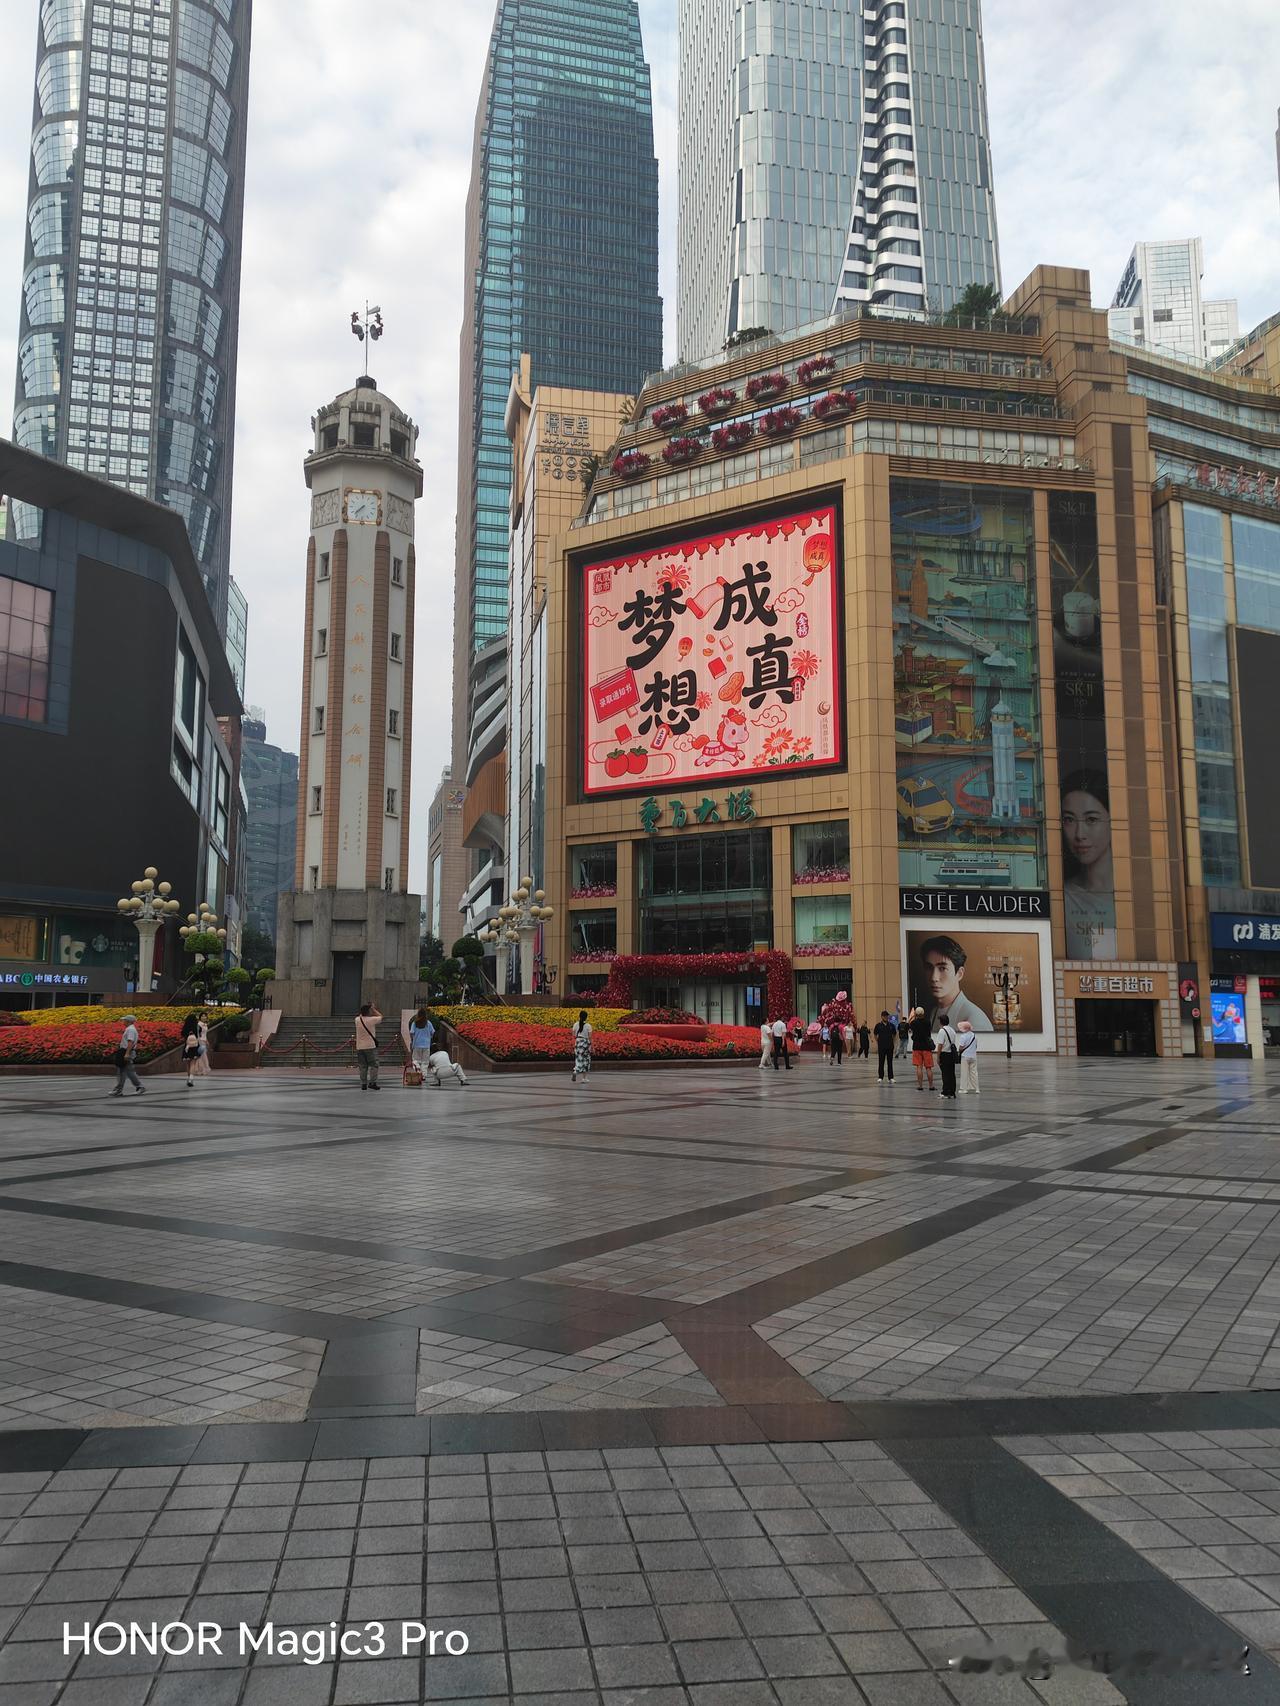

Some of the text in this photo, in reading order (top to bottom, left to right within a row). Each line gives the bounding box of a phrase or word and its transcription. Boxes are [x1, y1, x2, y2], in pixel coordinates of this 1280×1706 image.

[599, 683, 633, 708] 录取通知书
[965, 895, 1042, 913] LAUDER
[35, 973, 89, 985] 中国农业银行
[1093, 975, 1154, 993] 重百超市
